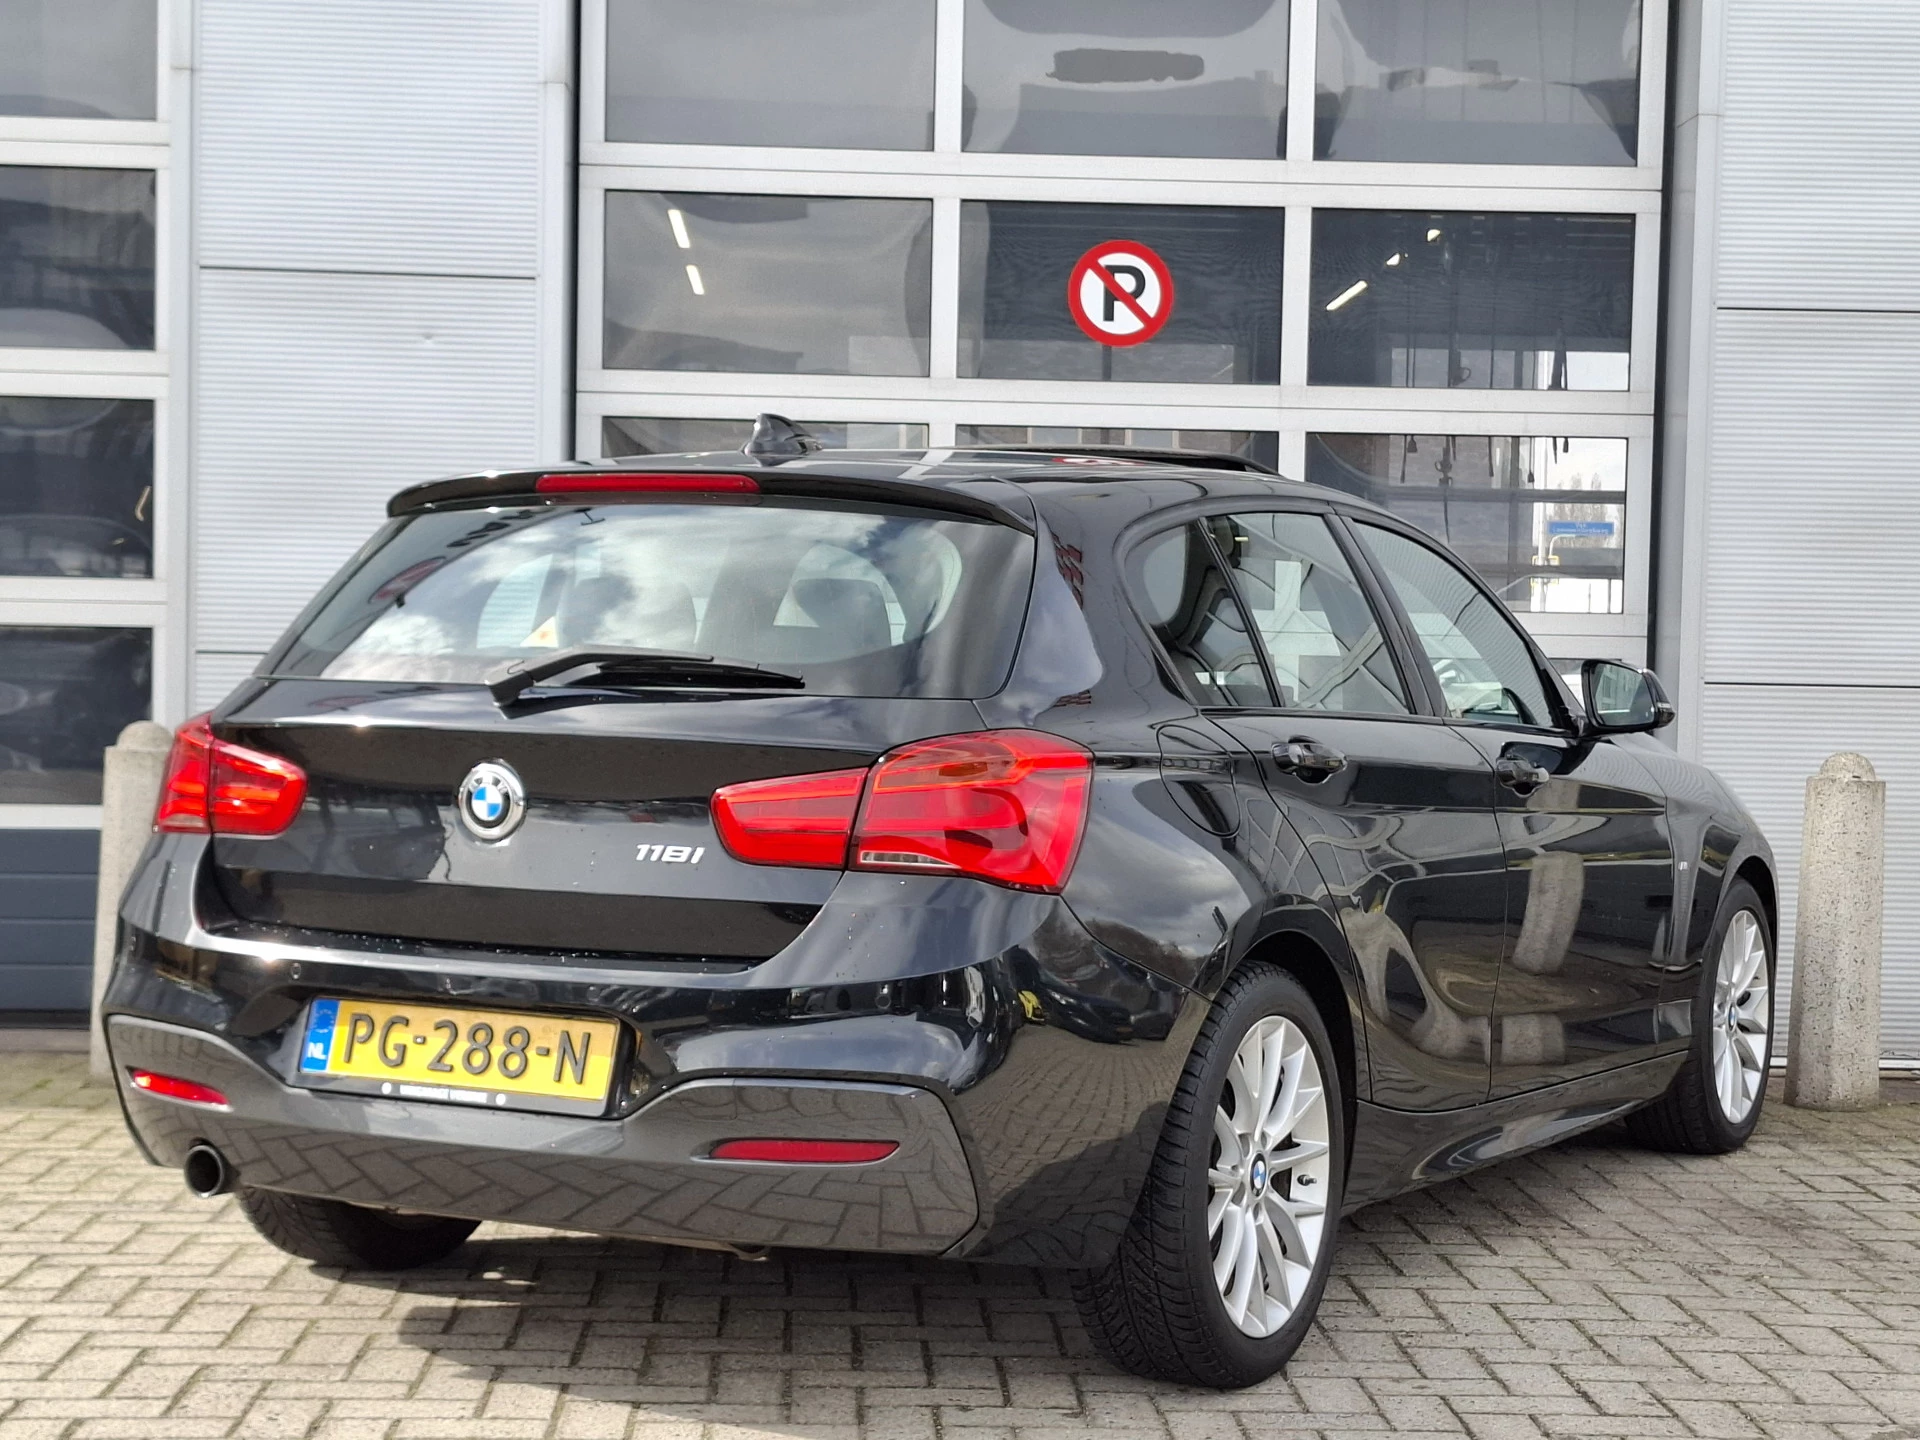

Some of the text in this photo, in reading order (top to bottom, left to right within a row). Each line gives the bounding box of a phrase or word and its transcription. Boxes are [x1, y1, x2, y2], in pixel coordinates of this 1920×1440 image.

[1103, 265, 1145, 322] P
[308, 1042, 326, 1060] NL
[343, 1013, 591, 1084] PG-288-N
